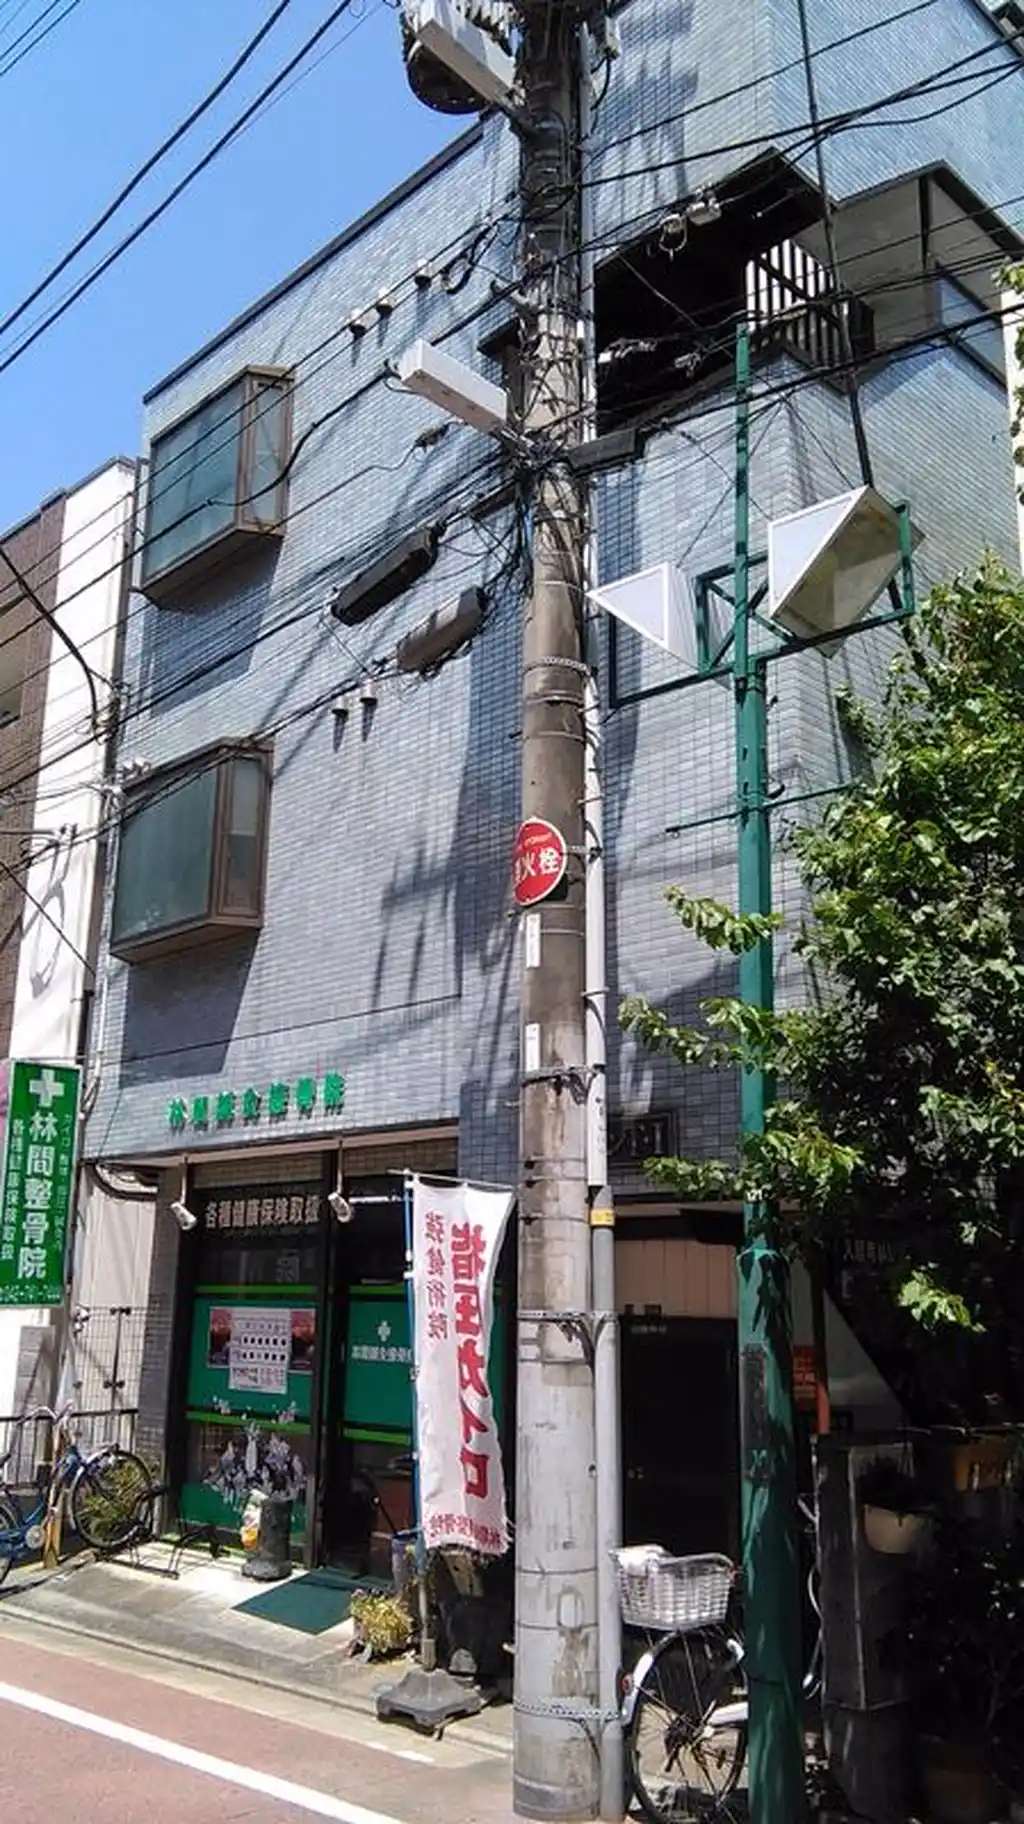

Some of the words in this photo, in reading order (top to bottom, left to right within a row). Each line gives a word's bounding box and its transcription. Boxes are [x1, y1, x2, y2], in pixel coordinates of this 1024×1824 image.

[18, 1111, 58, 1279] 林間整骨院
